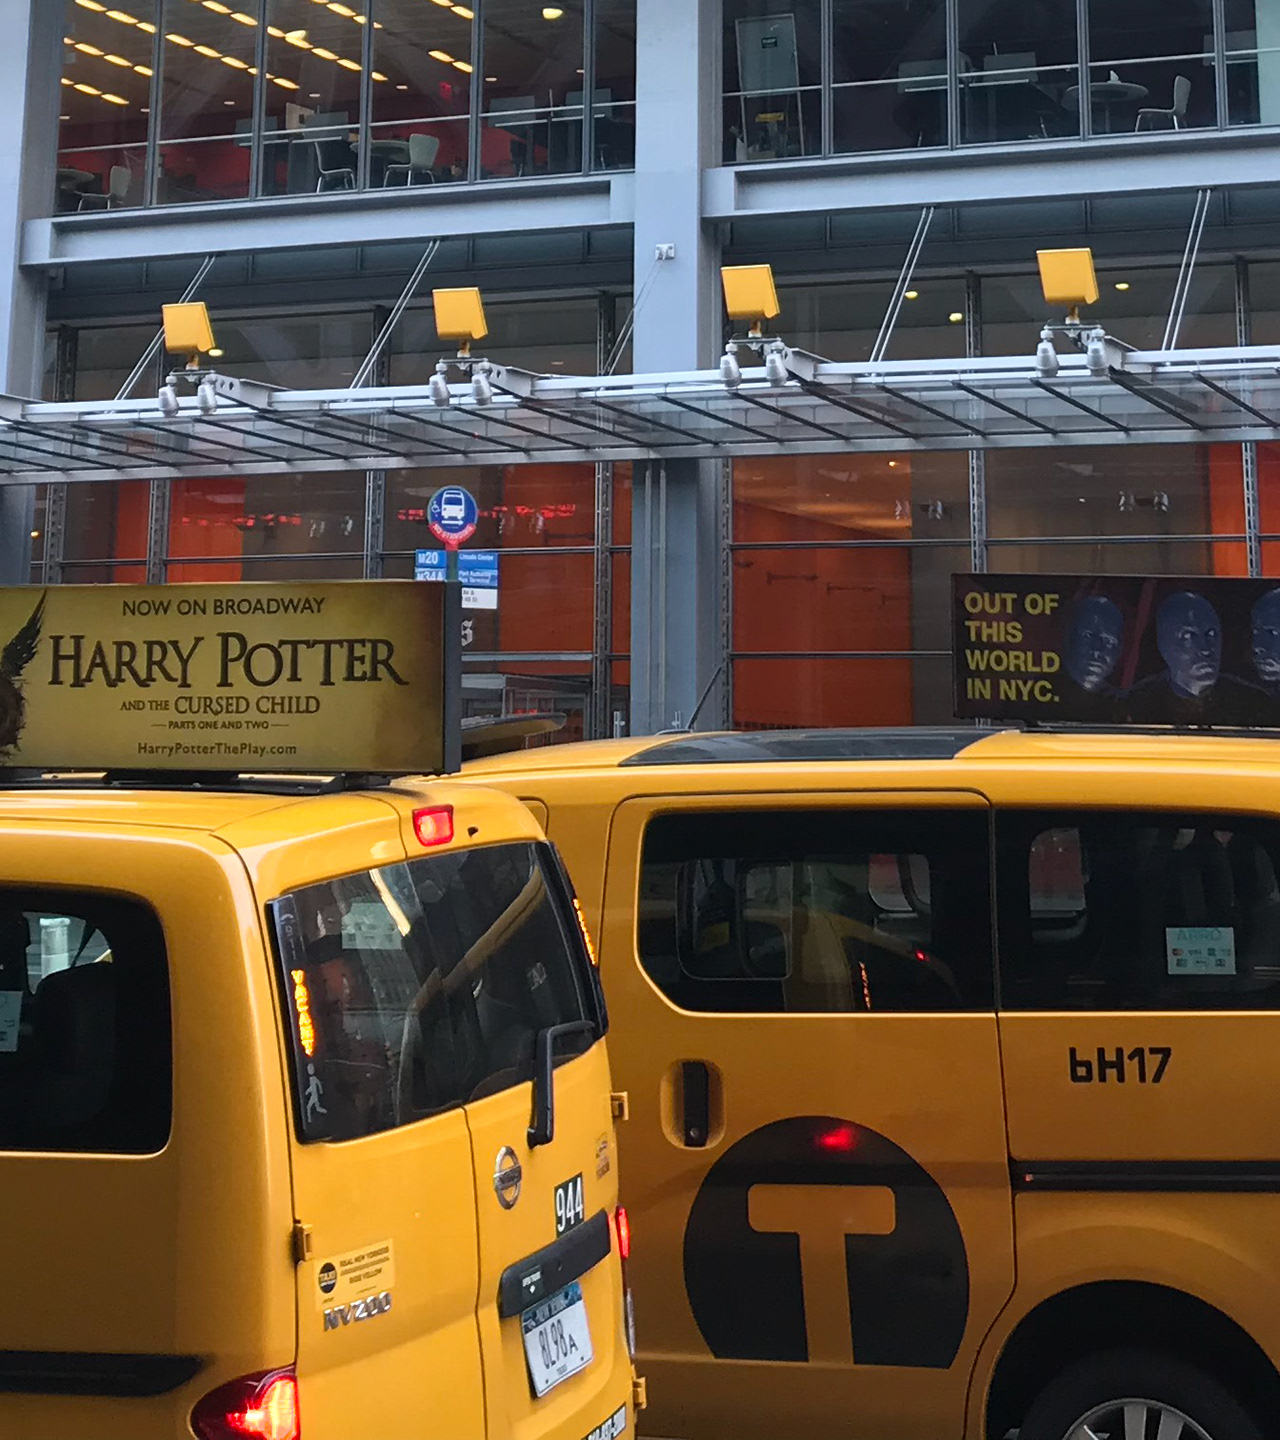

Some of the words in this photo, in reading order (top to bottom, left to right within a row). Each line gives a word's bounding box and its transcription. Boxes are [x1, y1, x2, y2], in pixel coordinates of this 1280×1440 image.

[418, 552, 439, 565] M20
[122, 599, 170, 617] NOW
[177, 599, 207, 616] ON
[213, 597, 325, 615] BROADWAY
[964, 592, 1018, 614] OUT
[1024, 593, 1060, 615] OF
[964, 620, 1023, 643] THIS
[48, 634, 204, 688] HARRY
[216, 632, 410, 688] POTTER
[965, 648, 1060, 672] WORLD
[967, 678, 991, 699] IN
[999, 678, 1060, 702] NYC.
[120, 699, 145, 711] AND
[148, 699, 169, 711] THE
[174, 696, 250, 716] CURSED
[256, 696, 320, 714] CHILD
[168, 720, 196, 730] PARTS
[198, 720, 218, 730] ONE
[220, 720, 243, 729] AND
[244, 720, 270, 729] TWO
[137, 742, 297, 757] HarryPotterThePlay.com
[556, 1174, 584, 1234] 944
